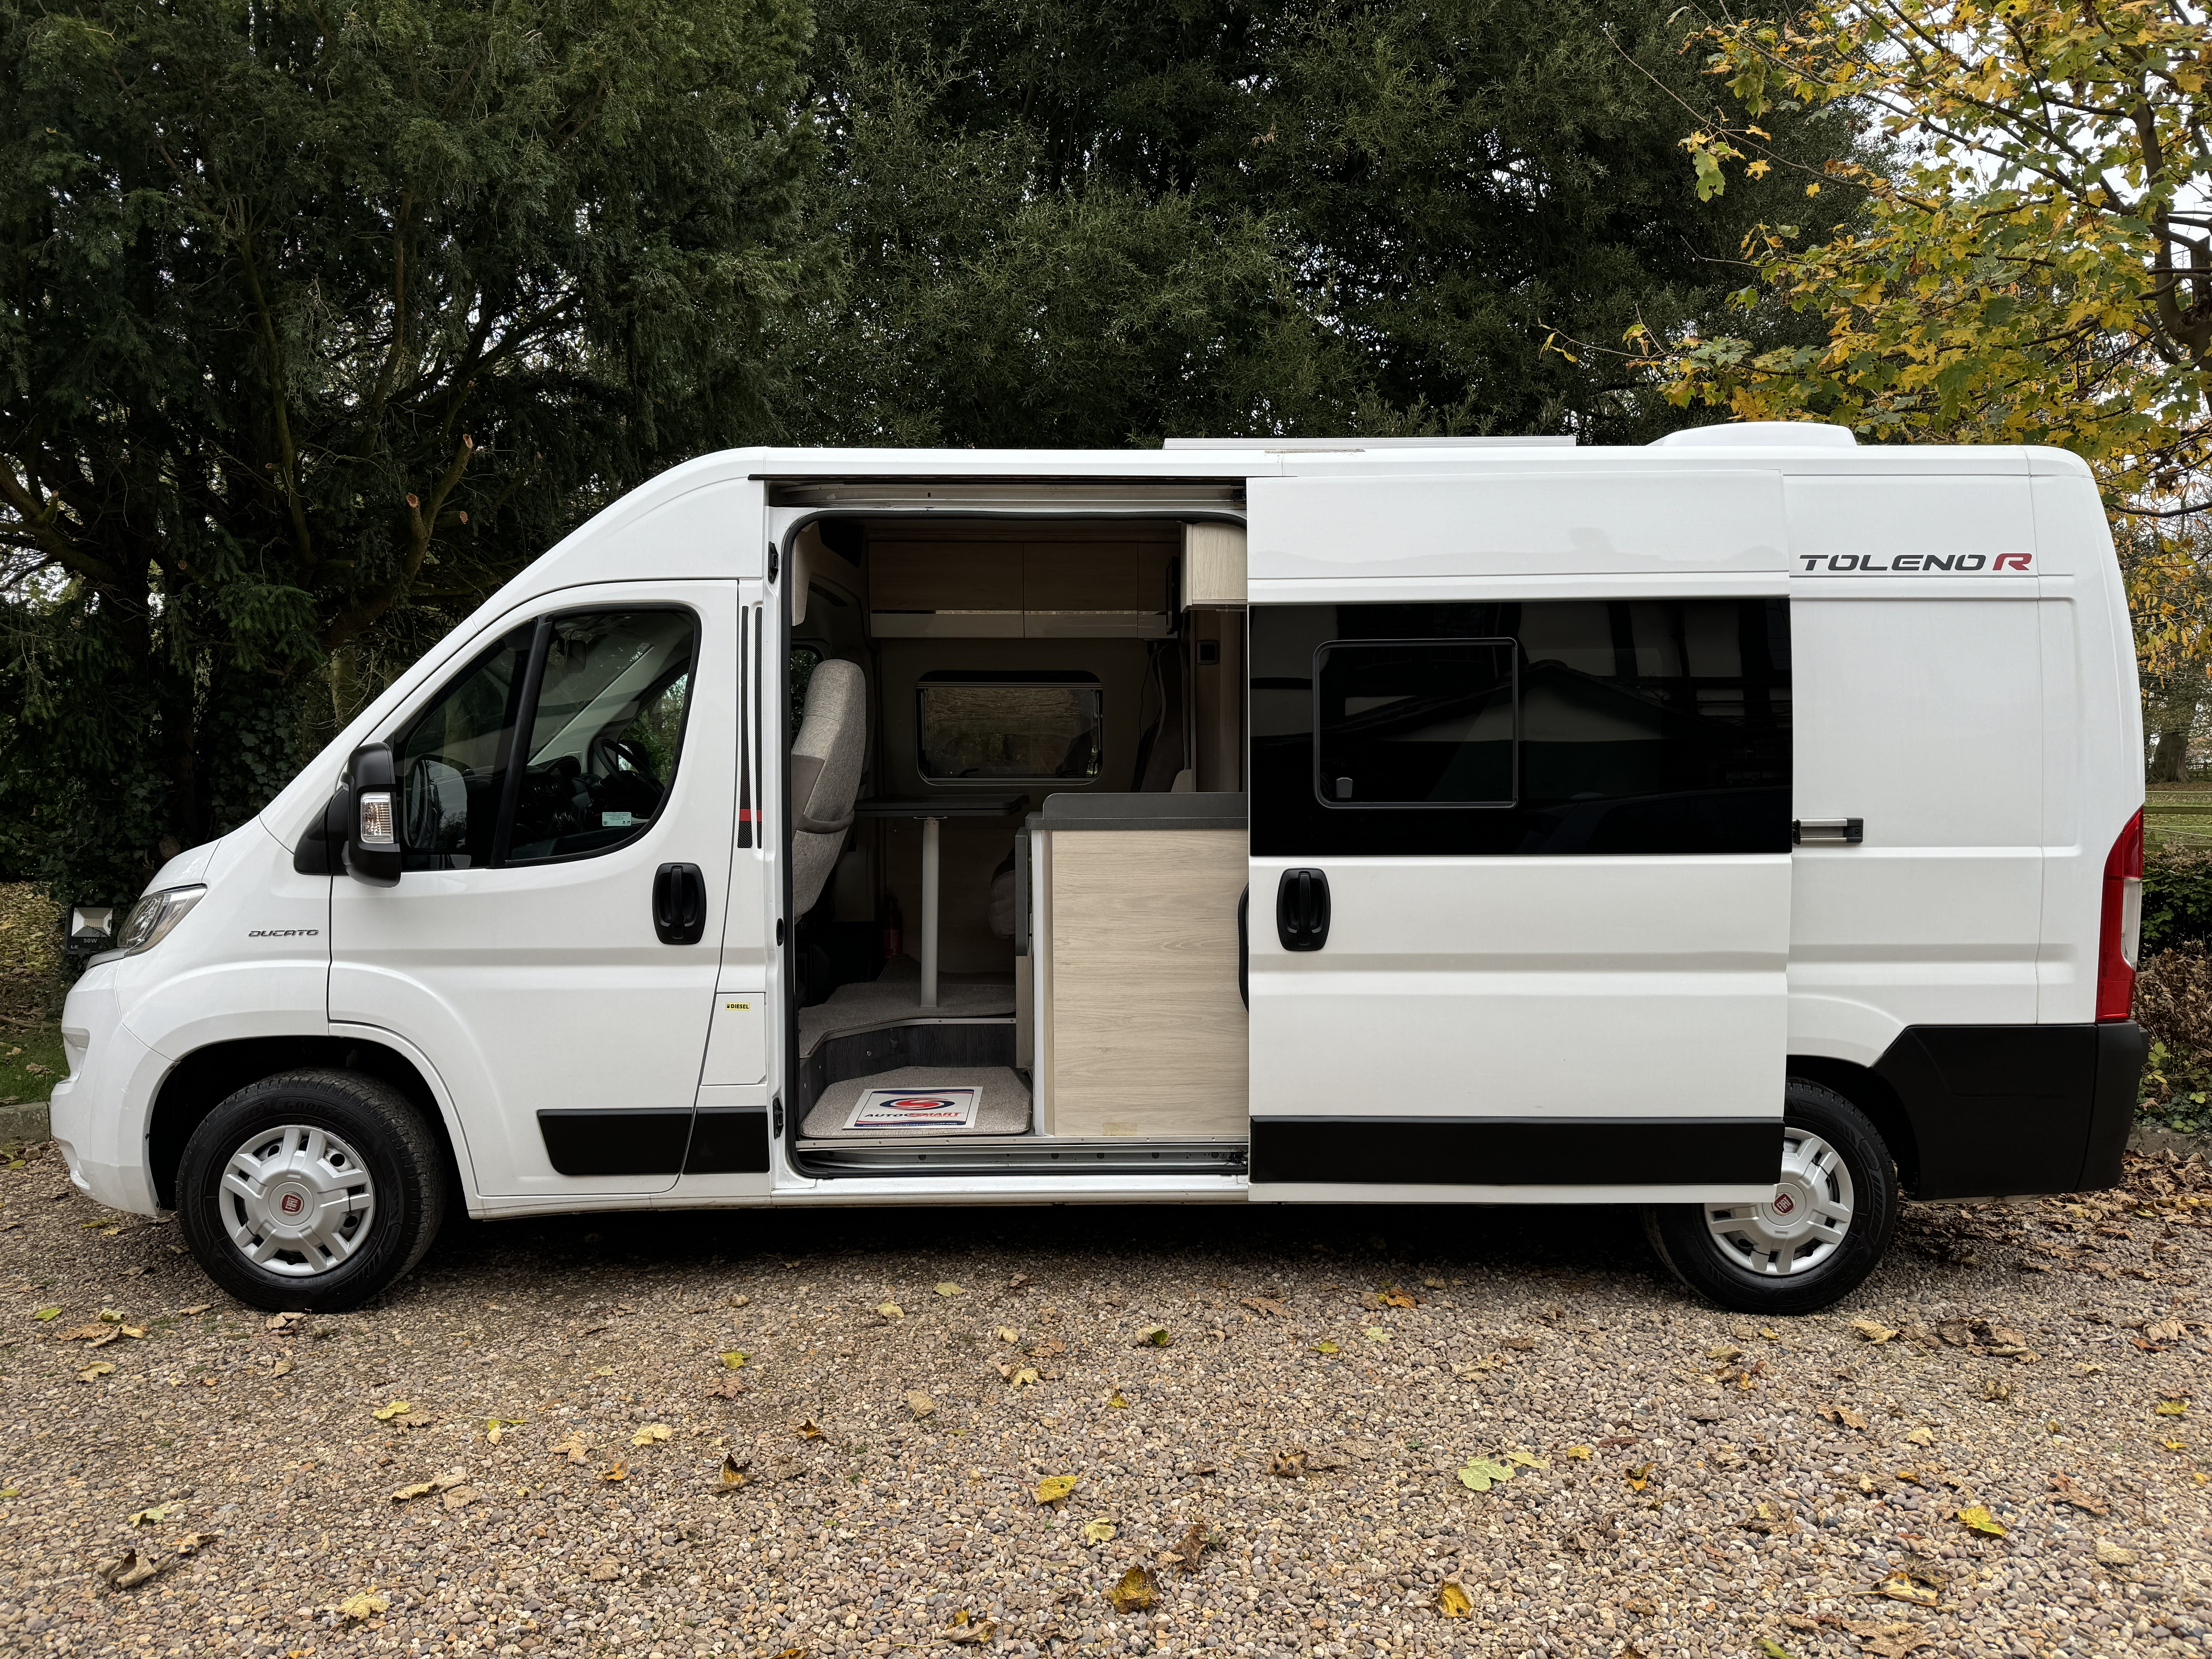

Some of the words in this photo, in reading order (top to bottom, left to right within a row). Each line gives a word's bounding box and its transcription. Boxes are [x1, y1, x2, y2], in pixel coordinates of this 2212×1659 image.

[1799, 555, 1986, 571] TOLENO
[1992, 553, 2033, 570] R
[285, 1196, 298, 1211] FIAT
[1776, 1196, 1791, 1211] FIAT
